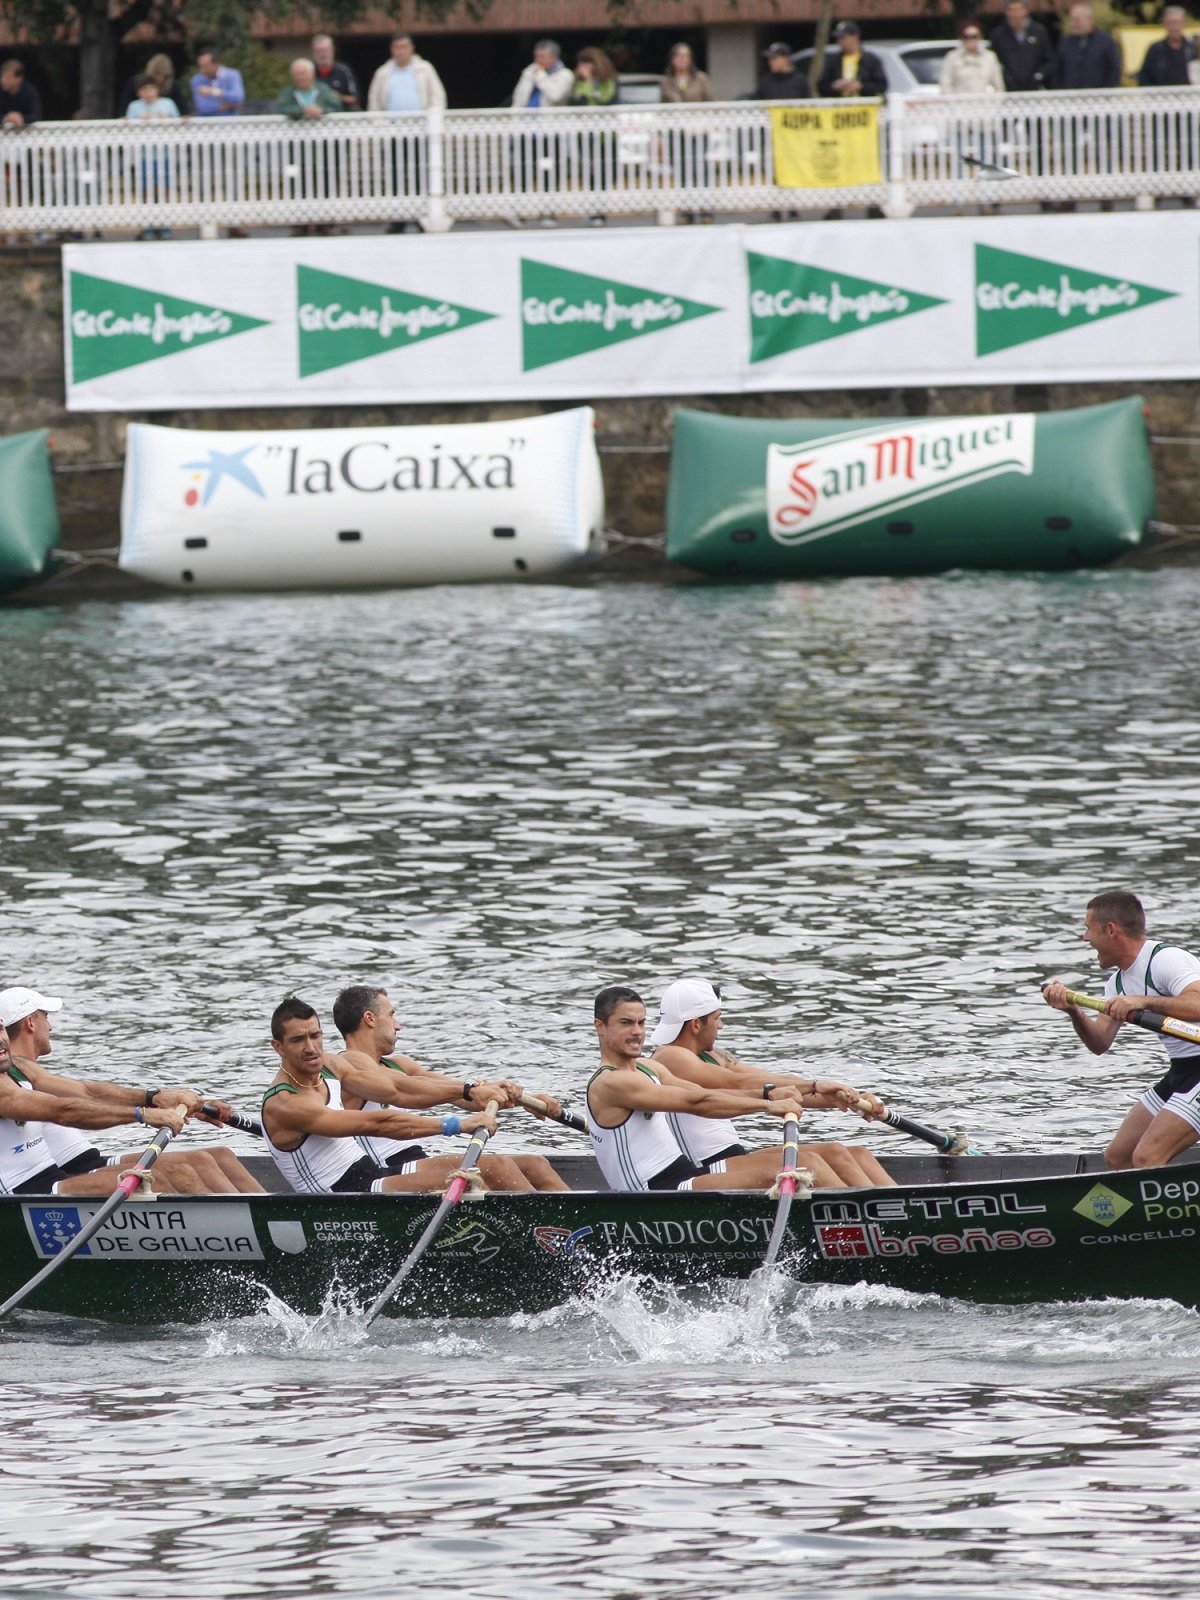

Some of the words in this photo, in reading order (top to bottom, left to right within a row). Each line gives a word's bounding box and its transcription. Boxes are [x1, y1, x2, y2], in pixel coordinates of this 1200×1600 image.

[1140, 1180, 1200, 1202] Dep
[811, 1194, 1047, 1222] METAL
[1144, 1203, 1200, 1221] Pon
[313, 1221, 379, 1231] DEPORTE
[96, 1237, 133, 1251] DE
[139, 1236, 253, 1251] GALICIA
[868, 1224, 1055, 1256] brañas
[1080, 1228, 1196, 1245] CONCELLO
